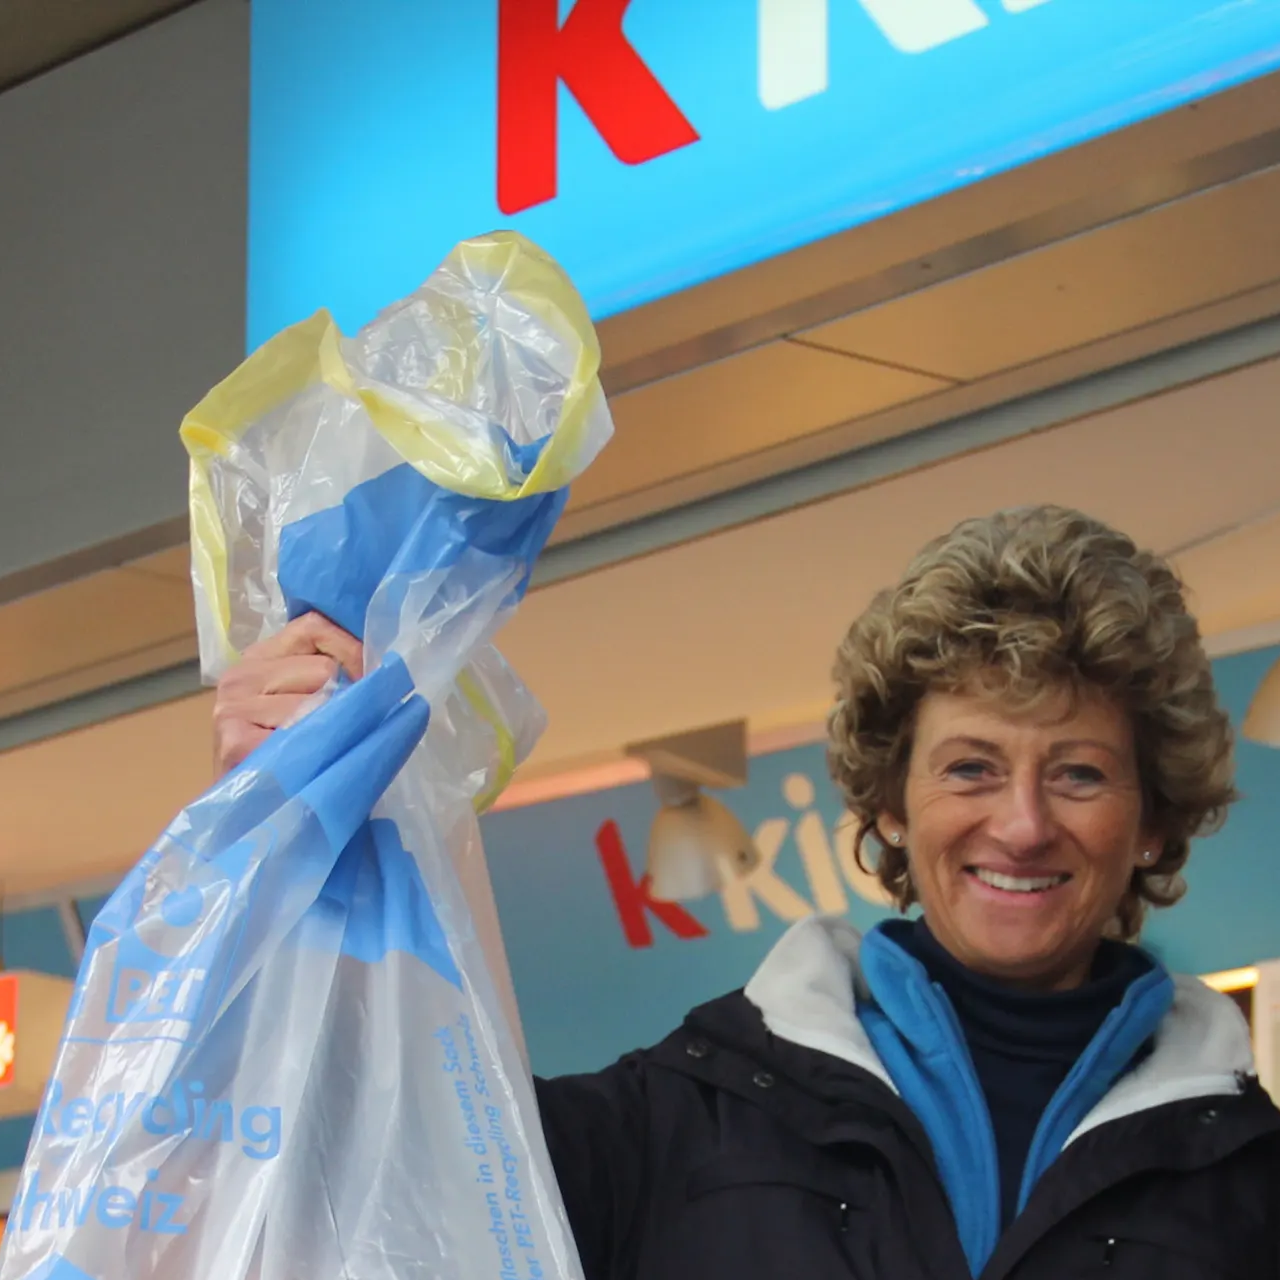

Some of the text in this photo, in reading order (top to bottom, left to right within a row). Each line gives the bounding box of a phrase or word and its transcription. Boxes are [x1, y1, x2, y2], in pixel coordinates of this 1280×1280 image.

[454, 1080, 487, 1156] diesem
[7, 1167, 188, 1235] hweiz
[476, 1163, 495, 1185] in
